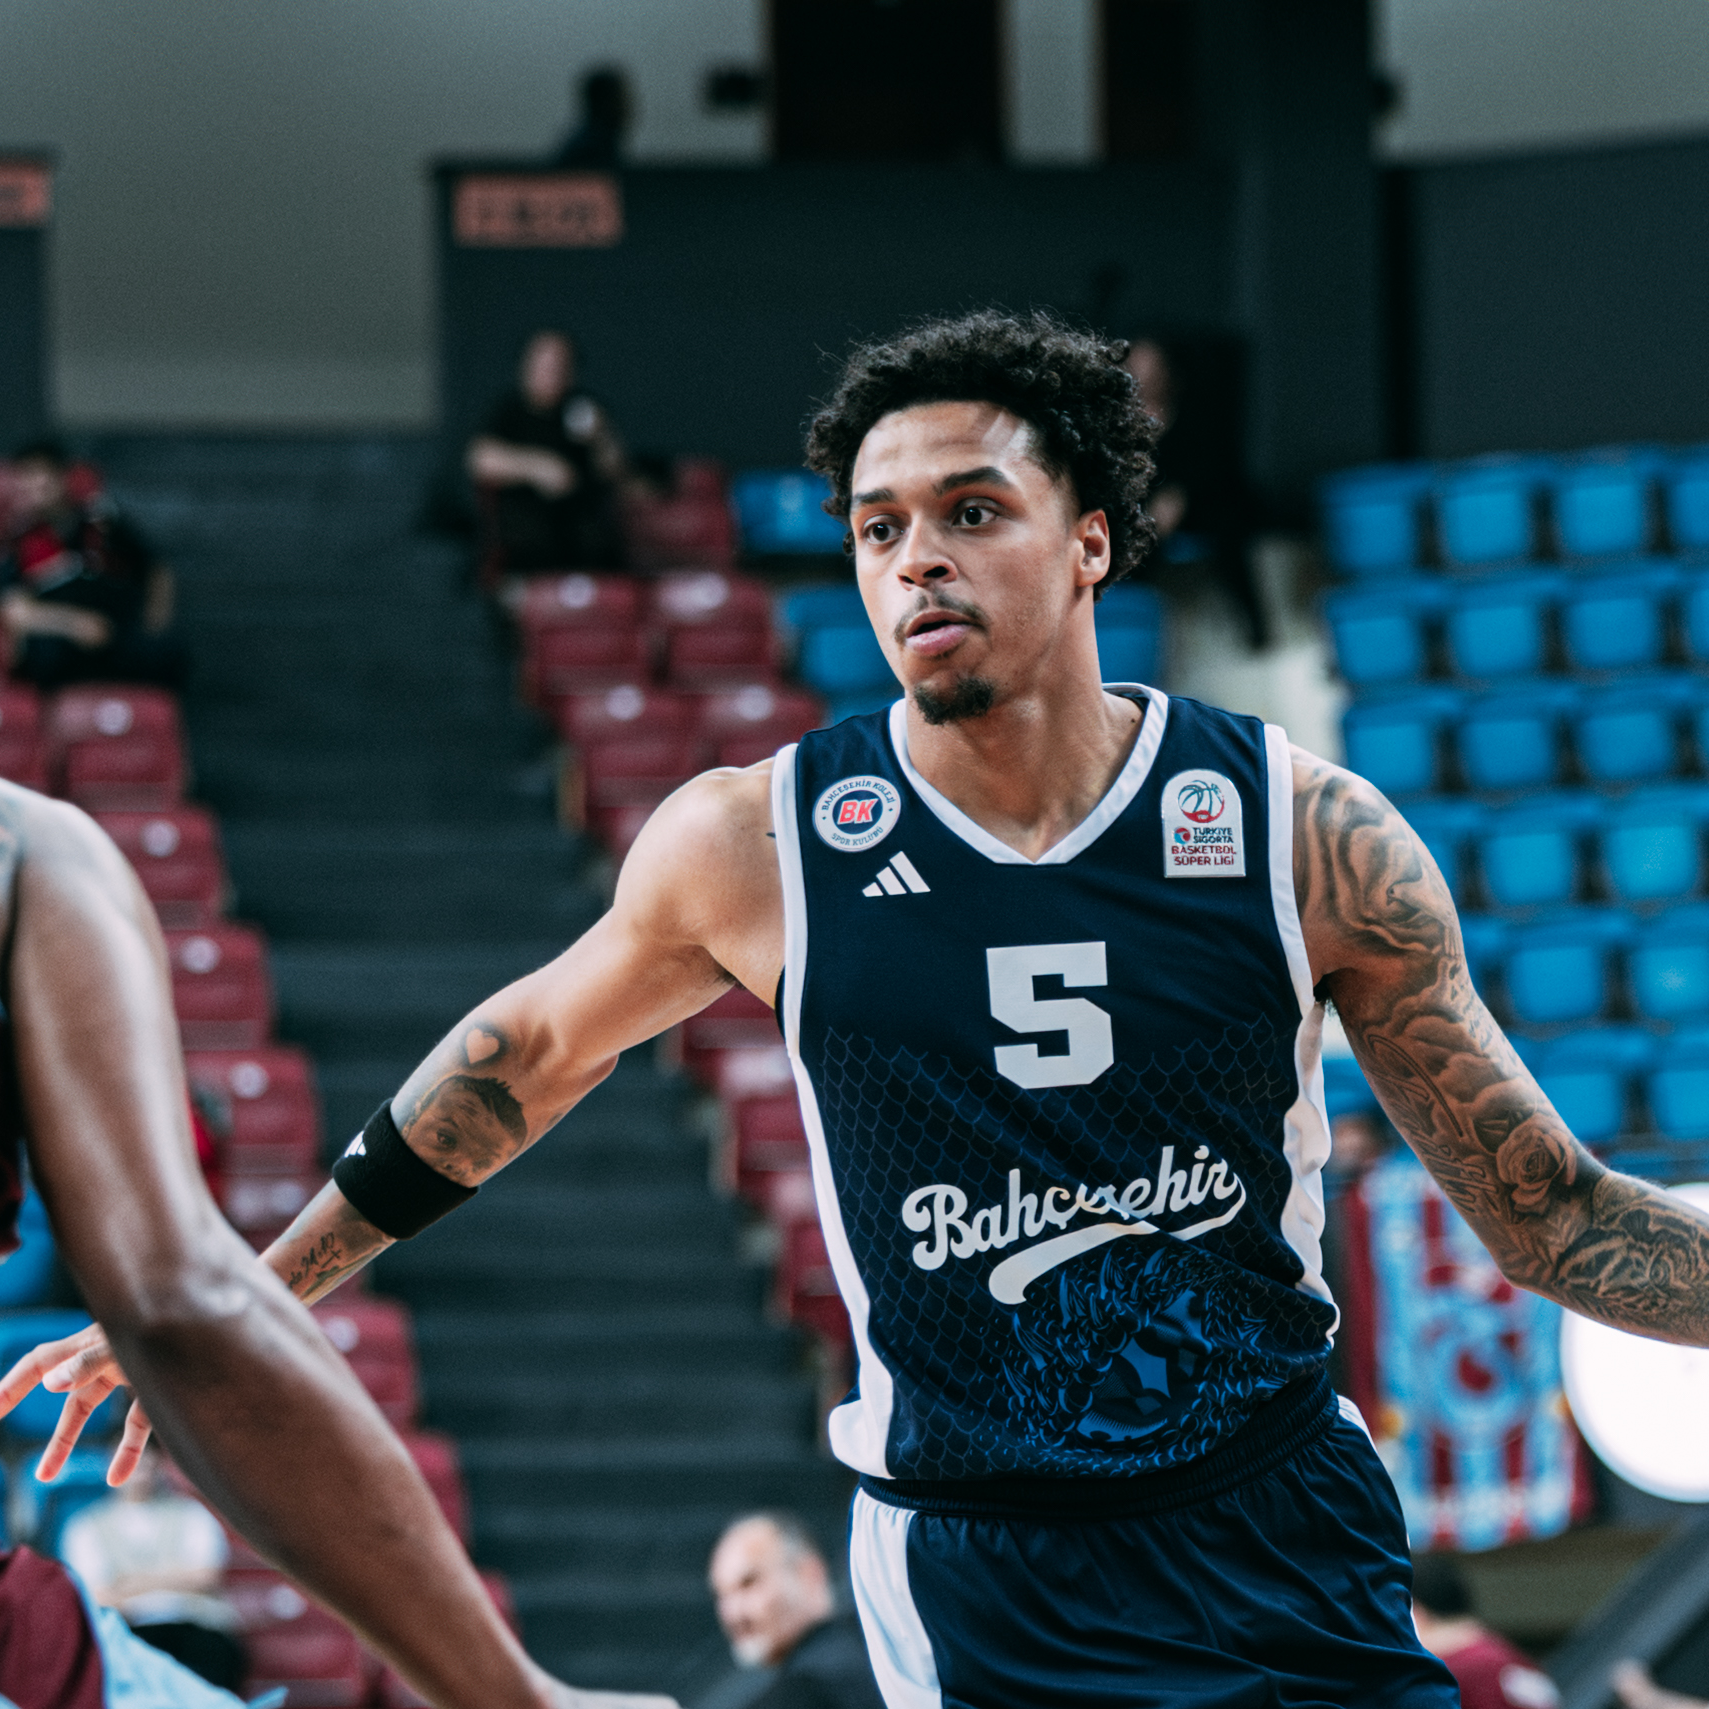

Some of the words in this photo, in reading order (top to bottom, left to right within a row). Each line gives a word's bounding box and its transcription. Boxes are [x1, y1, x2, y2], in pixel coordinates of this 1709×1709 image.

[837, 798, 879, 825] BK
[831, 832, 851, 846] SPOR
[1171, 845, 1237, 855] BASKETBOL
[985, 941, 1115, 1090] 5
